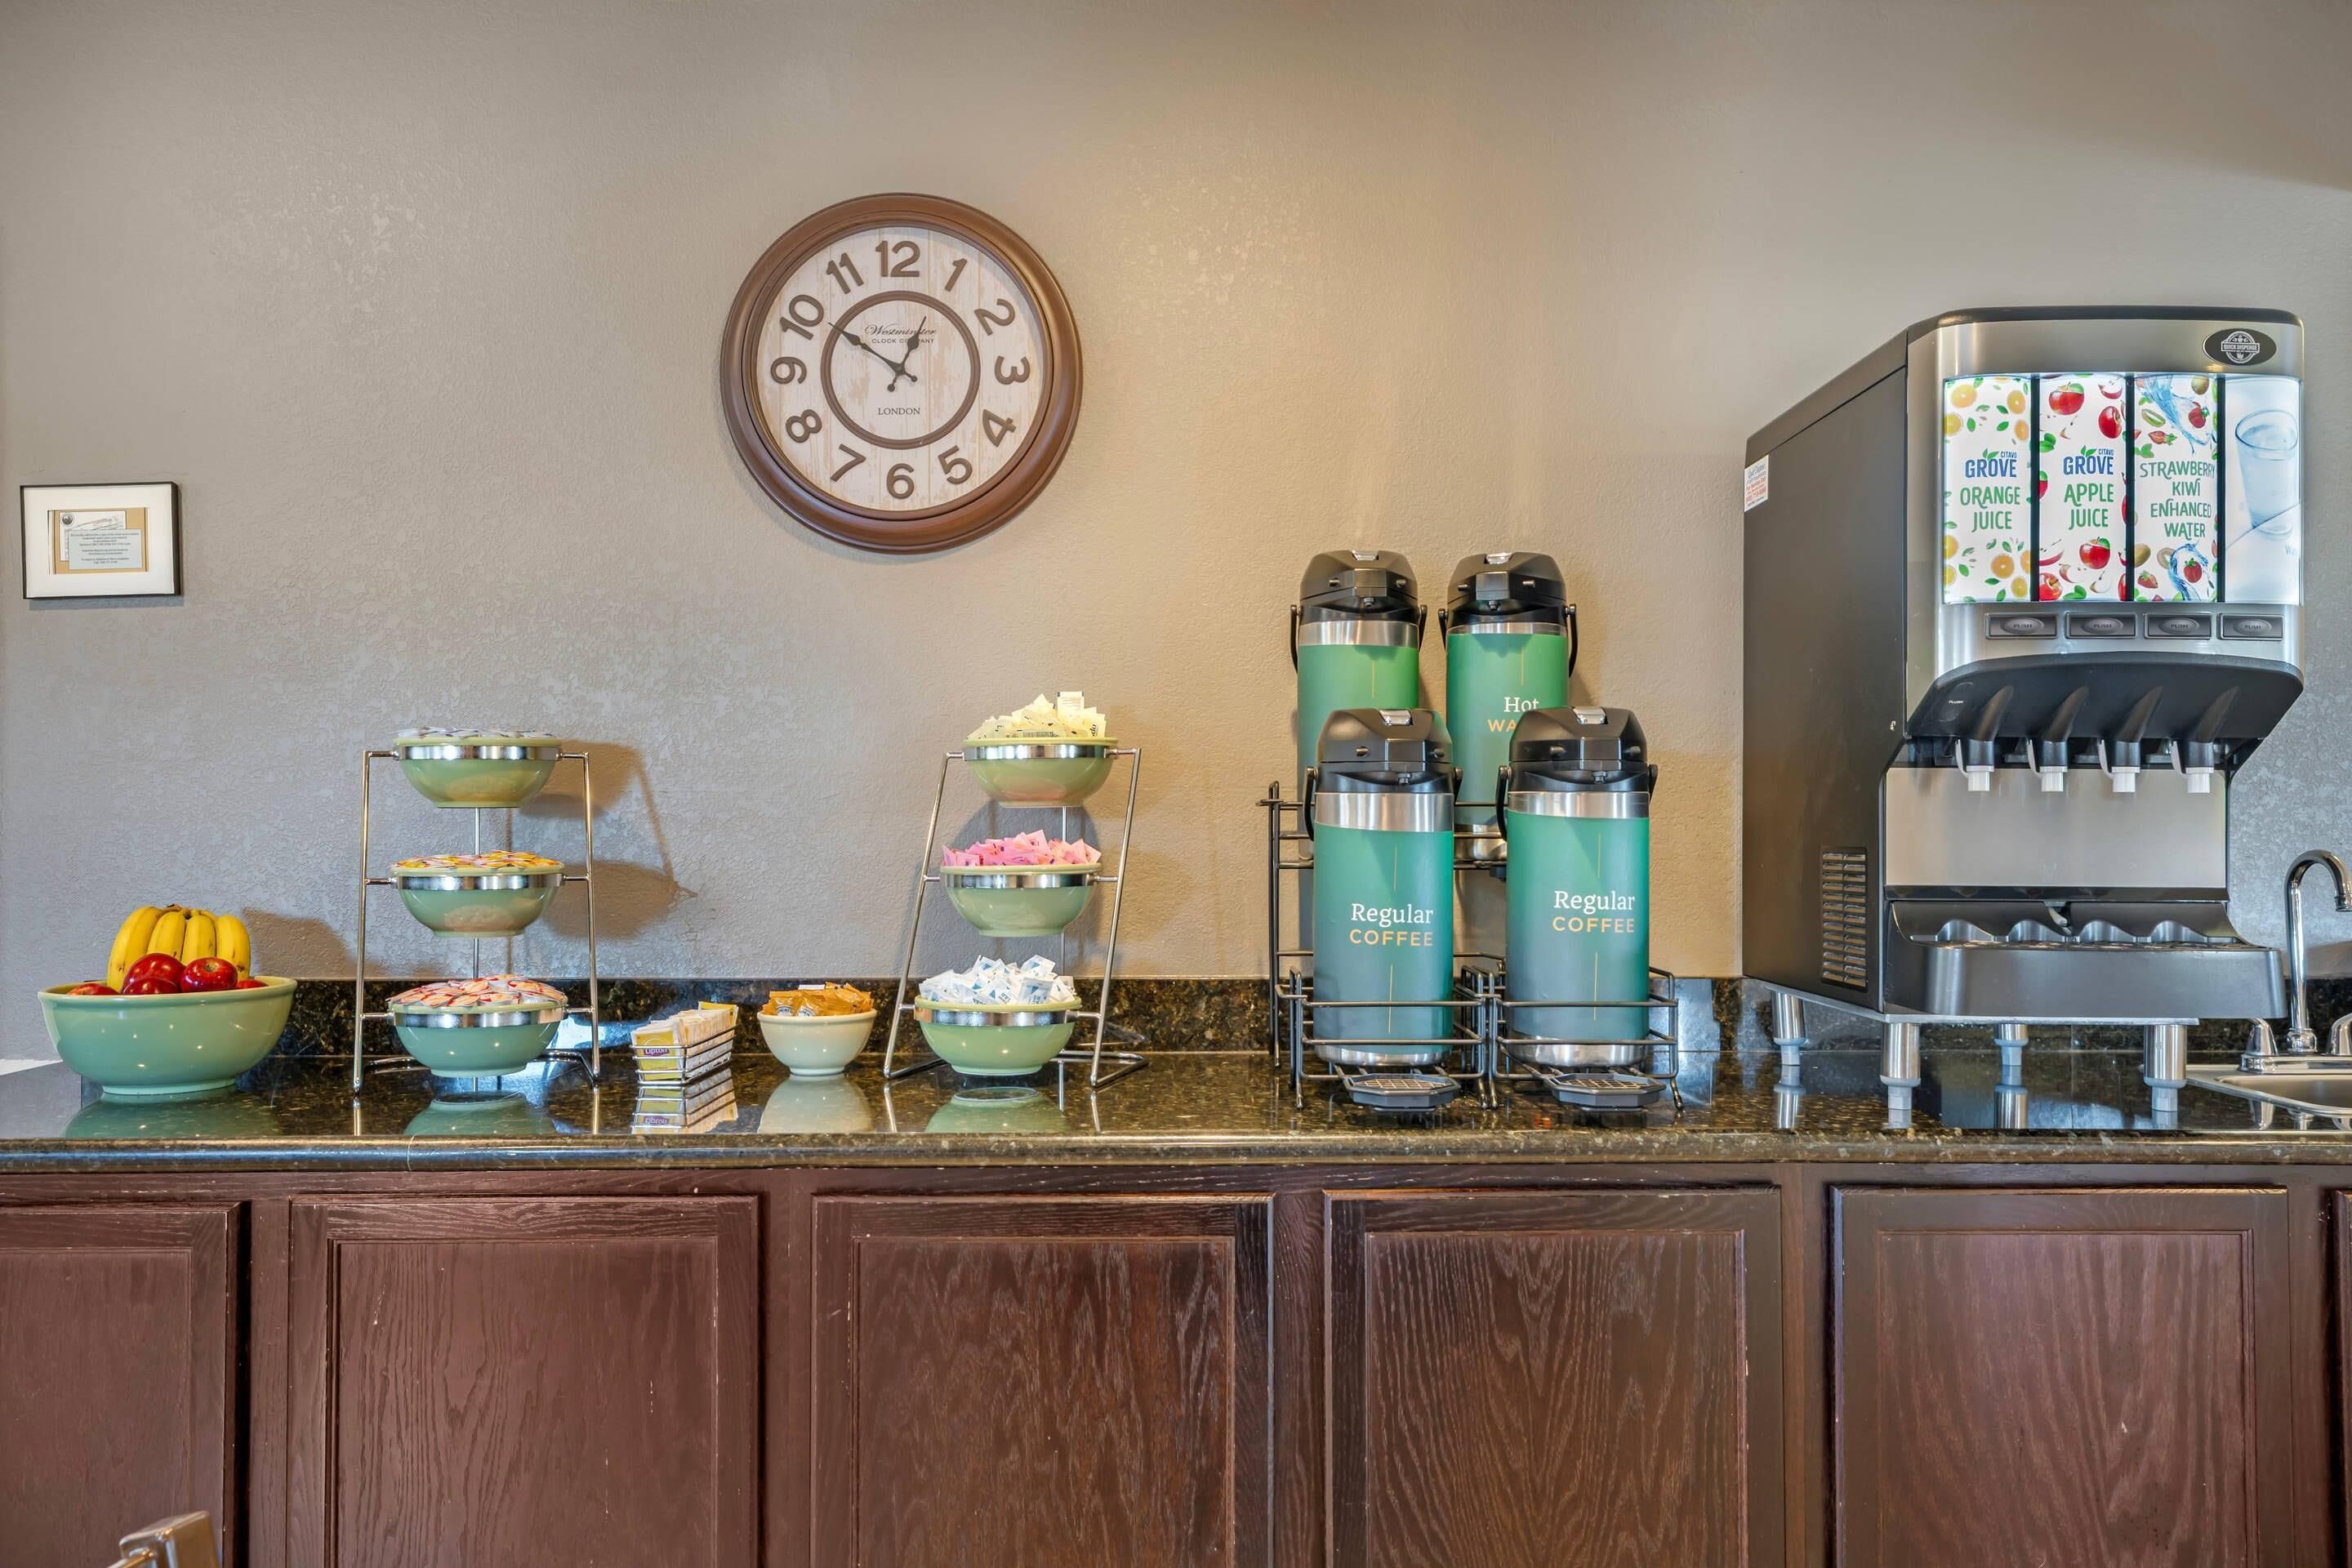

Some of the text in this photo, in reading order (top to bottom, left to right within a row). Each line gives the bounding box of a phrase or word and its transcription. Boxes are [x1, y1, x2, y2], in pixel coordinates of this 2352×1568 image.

[875, 240, 920, 277] 12
[826, 252, 864, 294] 11
[945, 258, 968, 292] 1
[779, 294, 824, 341] 10
[973, 298, 1015, 336] 2
[864, 323, 937, 336] Westminter
[770, 356, 807, 385] 9
[994, 355, 1031, 385] 3
[785, 409, 822, 443] 8
[982, 409, 1017, 448] 4
[830, 443, 866, 482] 7
[938, 445, 973, 484] 5
[1965, 458, 2017, 479] GROVE
[2063, 456, 2114, 475] GROVE
[2140, 461, 2215, 480] STRAWBERRY
[886, 463, 915, 499] 6
[2172, 478, 2201, 497] KIWI
[1960, 486, 2021, 509] ORANGE
[2064, 483, 2114, 506] APPLE
[2069, 508, 2109, 530] JUICE
[2150, 498, 2212, 518] ENHANCED
[1971, 511, 2012, 532] JUICE
[2164, 522, 2206, 541] WATER
[1503, 697, 1539, 713] Hot
[1553, 890, 1635, 915] Regular
[1351, 903, 1434, 928] Regular
[1552, 916, 1634, 933] COFFEE
[1350, 929, 1433, 947] COFFEE
